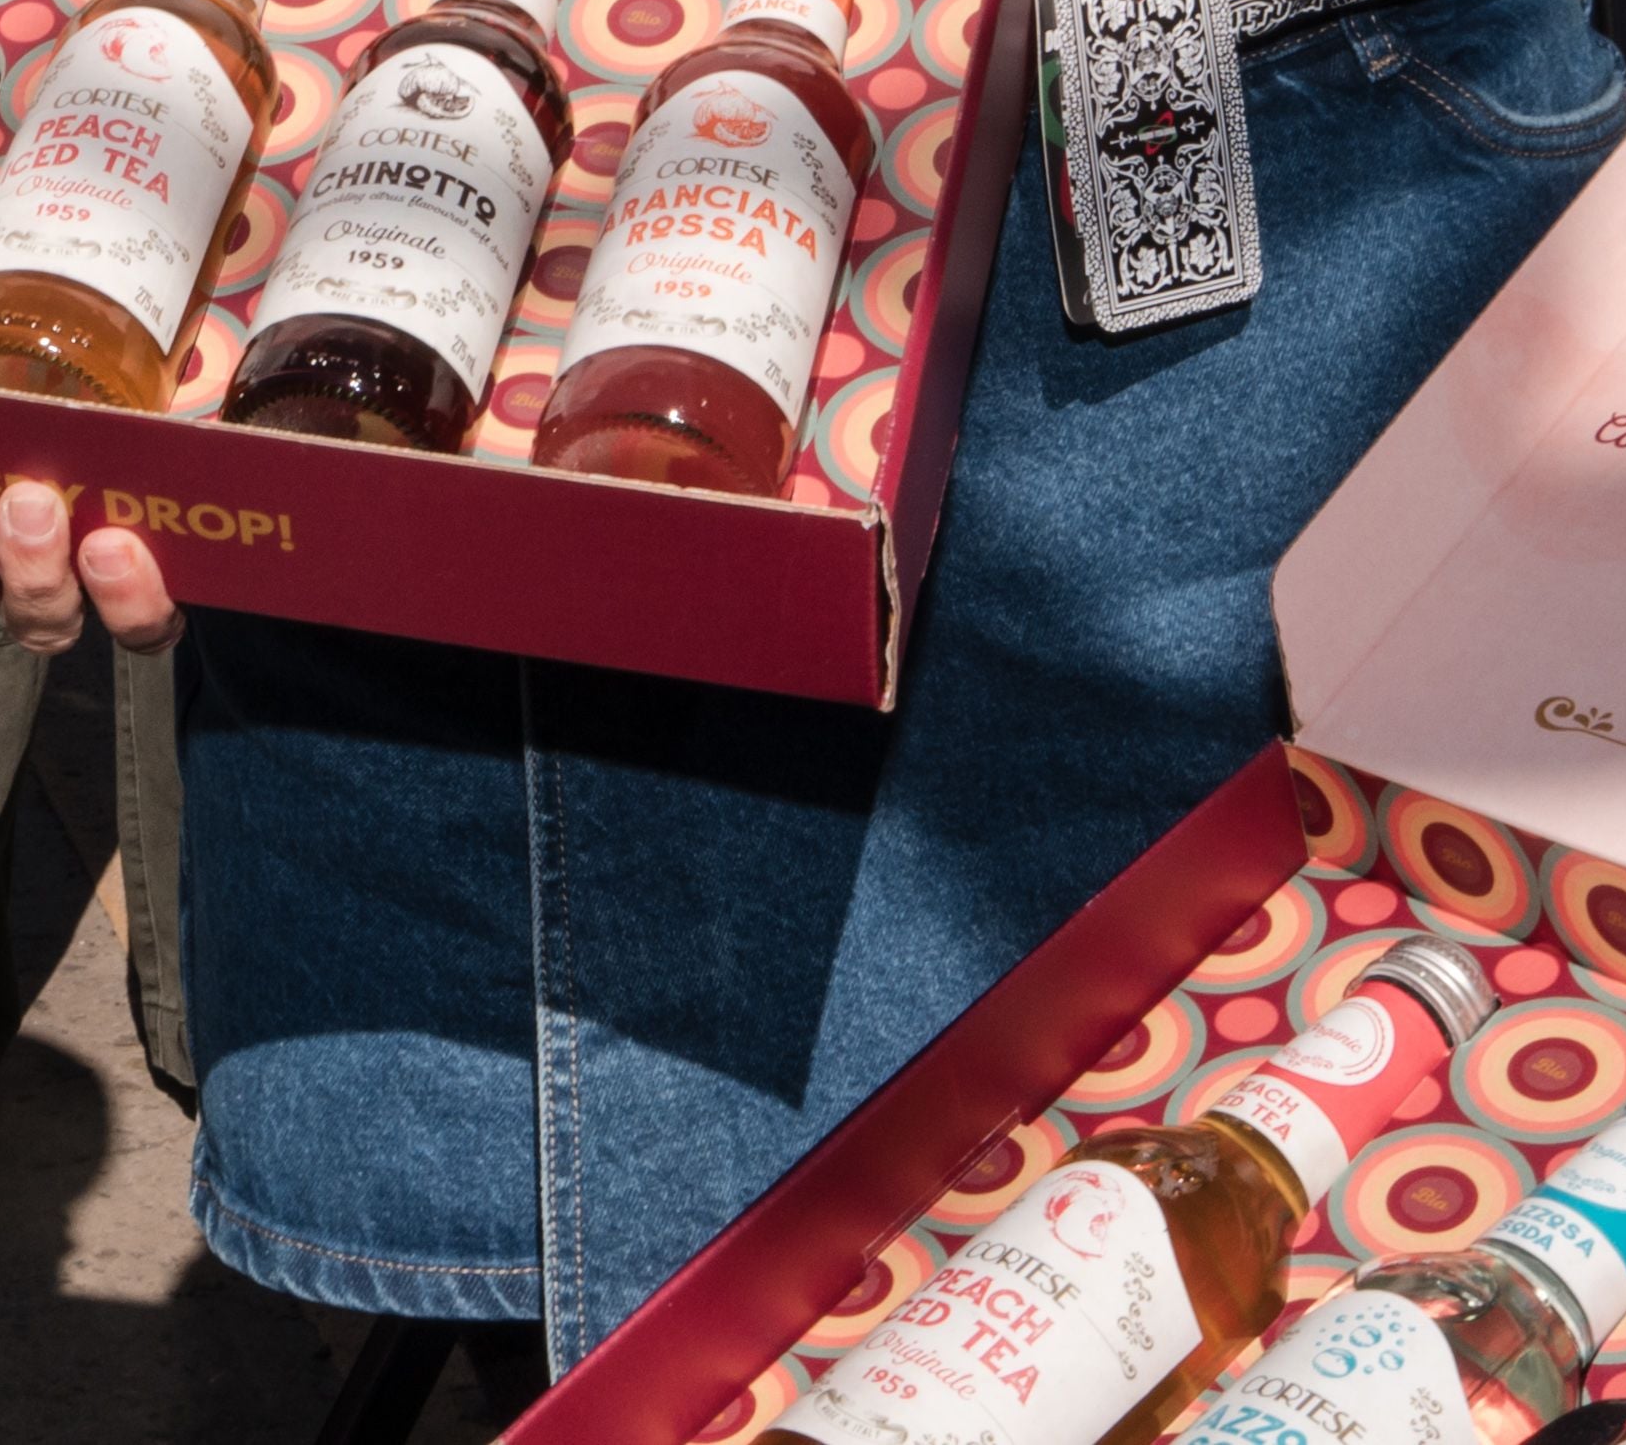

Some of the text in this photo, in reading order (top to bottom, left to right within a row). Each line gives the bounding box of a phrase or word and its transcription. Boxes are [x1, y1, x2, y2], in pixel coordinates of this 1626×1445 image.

[53, 88, 170, 125] CORTESE
[33, 113, 163, 157] PEACH
[358, 129, 479, 168] CORTESE
[0, 145, 171, 206] ICED TEA
[15, 174, 133, 210] Originale
[312, 160, 498, 228] CHINOTTO
[656, 156, 780, 192] CORTESE
[35, 202, 92, 222] 1959
[602, 182, 818, 262] ARANCIATA
[323, 218, 446, 261] Originale
[625, 212, 769, 260] ROSSA
[348, 250, 406, 271] 1959
[626, 250, 753, 287] Originale
[653, 280, 712, 299] 1959
[102, 489, 296, 552] DROP!
[1248, 1104, 1293, 1144] TEA
[964, 1238, 1081, 1311] CORTESE
[923, 1267, 1055, 1347] PEACH
[863, 1325, 980, 1401] Originale
[882, 1293, 1044, 1407] CED TEA
[862, 1365, 919, 1401] 1959
[1239, 1373, 1369, 1445] CORTESE
